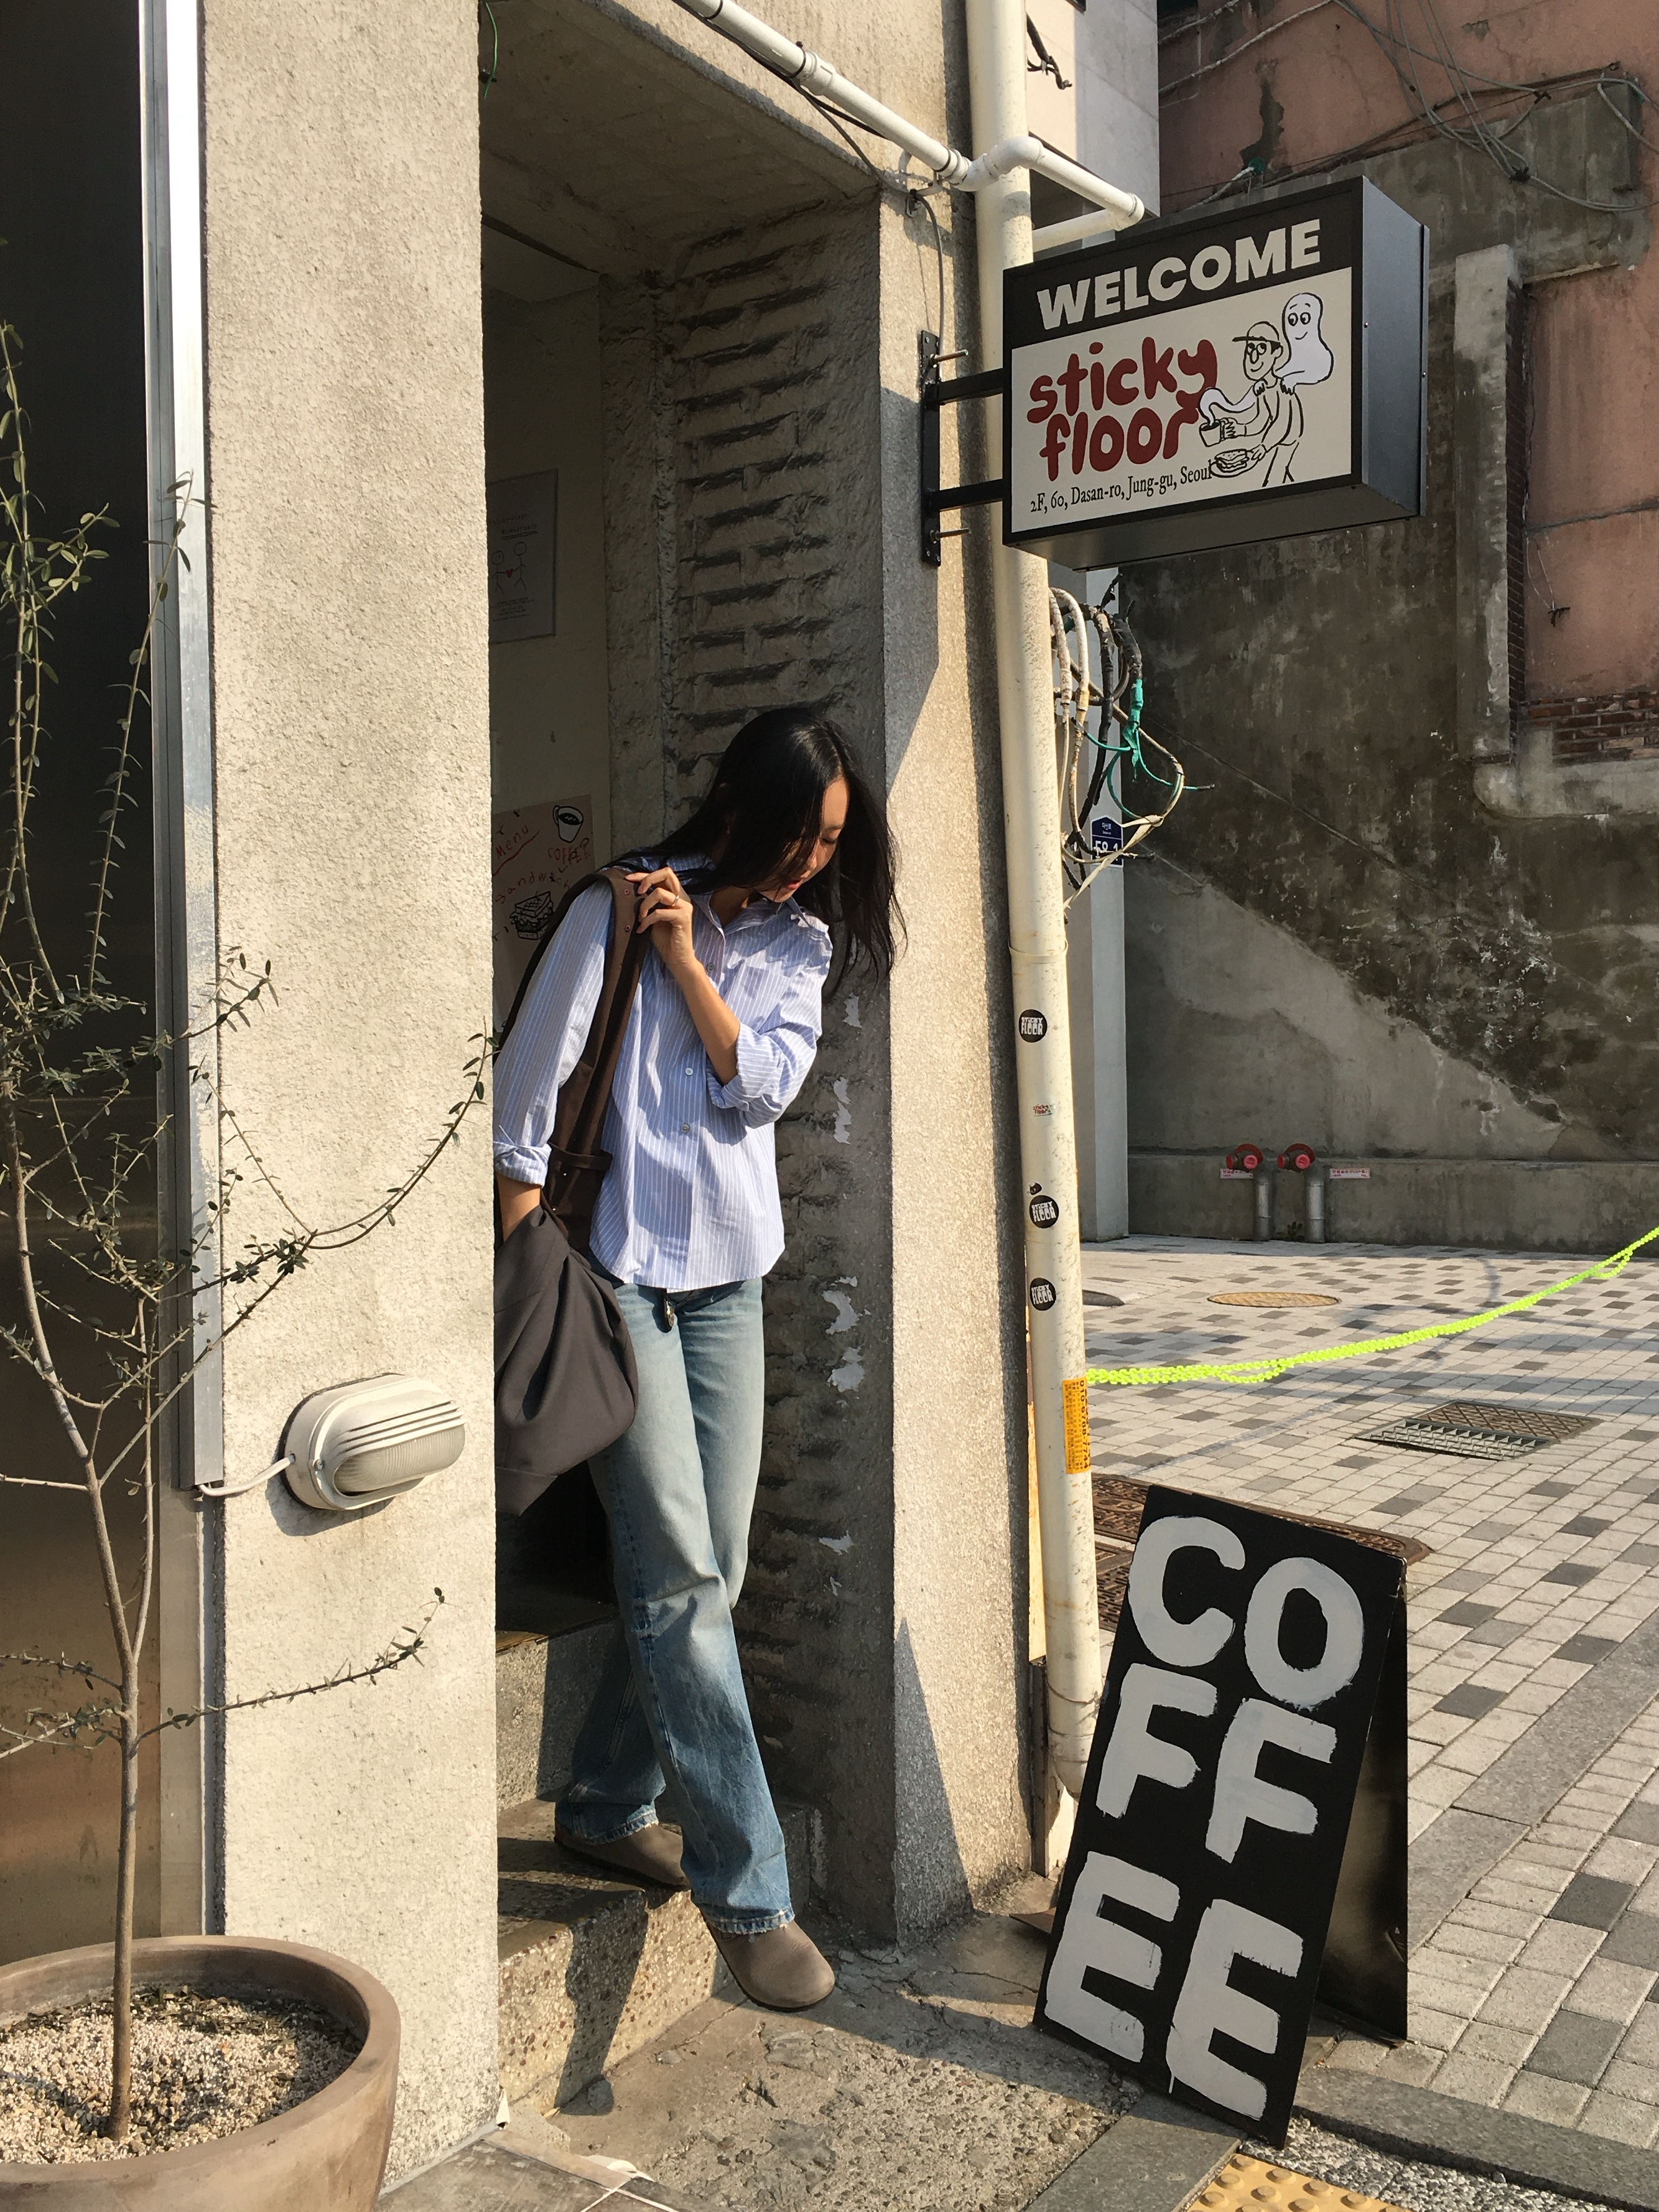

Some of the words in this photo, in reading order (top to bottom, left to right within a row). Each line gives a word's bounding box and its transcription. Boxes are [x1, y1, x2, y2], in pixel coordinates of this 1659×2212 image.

[1036, 218, 1321, 330] WELCOME
[1026, 337, 1218, 424] sticky
[1039, 407, 1199, 481] floor
[1030, 492, 1048, 514] 2F,
[1050, 490, 1068, 511] 60,
[1071, 484, 1125, 505] Dasan-ro,
[1127, 474, 1177, 501] Jung-gu,
[1180, 459, 1212, 485] Seoul
[496, 824, 529, 860] Menu
[547, 845, 591, 865] COFFEE
[1021, 1023, 1043, 1035] FLOOR
